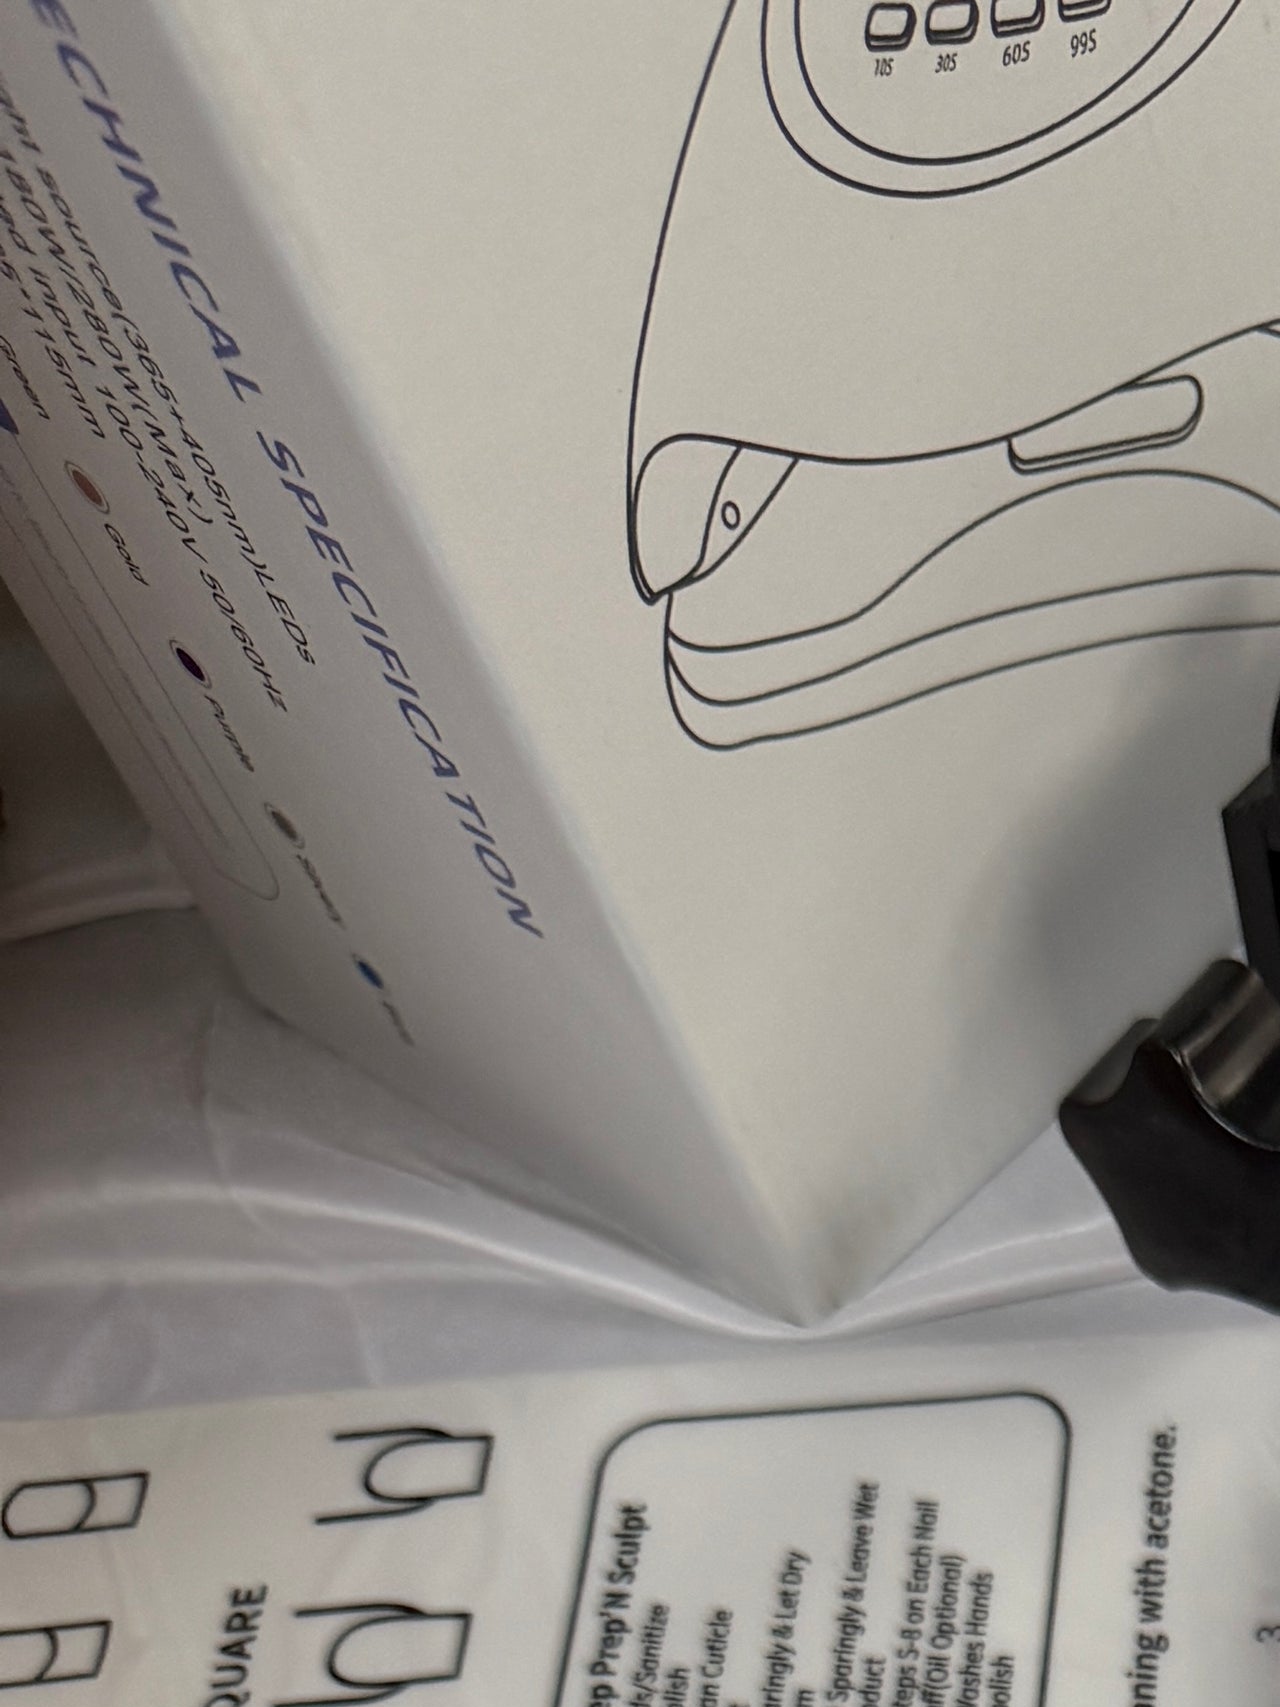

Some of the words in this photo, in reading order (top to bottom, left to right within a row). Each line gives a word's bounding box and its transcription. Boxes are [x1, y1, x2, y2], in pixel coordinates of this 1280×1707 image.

[934, 52, 958, 74] 30S
[1001, 39, 1032, 68] 60S
[1069, 27, 1098, 59] 99S
[95, 385, 209, 564] 100-240V
[199, 569, 288, 713] 50/60Hz
[103, 522, 151, 587] Gold
[256, 430, 545, 939] SPECIFICATION
[854, 1483, 876, 1520] Wet
[1144, 1426, 1177, 1550] acetone.
[606, 1505, 649, 1584] Sculpt
[913, 1501, 937, 1540] Nail
[780, 1551, 810, 1586] Dry
[845, 1524, 870, 1582] Leave
[906, 1545, 932, 1593] Each
[774, 1589, 797, 1619] Let
[841, 1586, 864, 1602] &
[929, 1555, 964, 1650] Optional)
[964, 1573, 993, 1636] Hands
[1133, 1557, 1166, 1624] with
[700, 1610, 729, 1679] Cuticle
[771, 1624, 793, 1639] &
[825, 1605, 866, 1701] Sparingly
